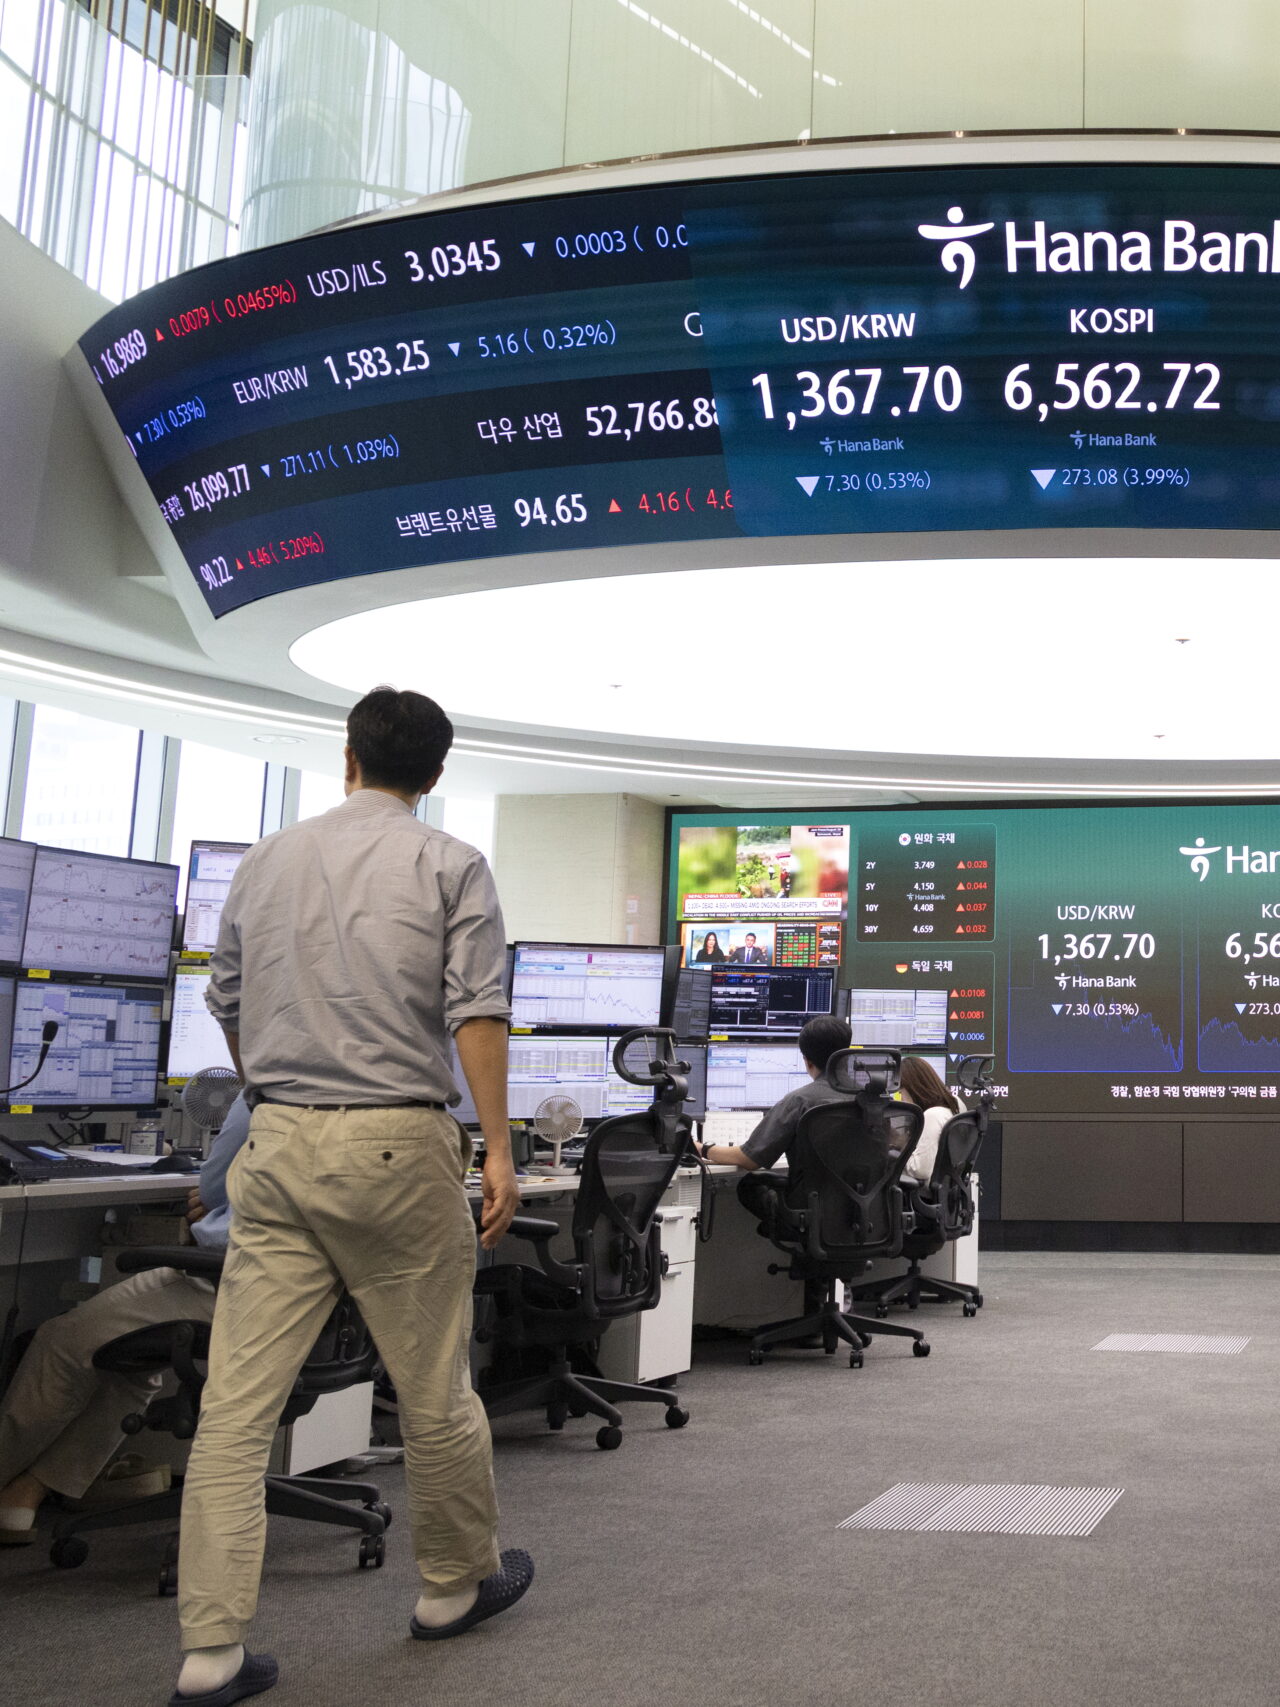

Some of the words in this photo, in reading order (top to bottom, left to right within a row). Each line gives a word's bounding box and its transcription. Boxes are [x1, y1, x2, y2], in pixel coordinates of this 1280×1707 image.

[1005, 220, 1152, 273] Hana
[100, 328, 148, 379] 16.9869
[308, 261, 386, 296] USD/ILS
[404, 238, 500, 282] 3.0345
[781, 313, 916, 343] USD/KRW
[1070, 307, 1154, 334] KOSPI
[233, 366, 308, 403] EUR/KRW
[324, 340, 430, 389] 1,583.25
[752, 365, 962, 431] 1,367.70
[1004, 363, 1221, 422] 6,562.72
[838, 439, 871, 452] Hana
[872, 437, 904, 451] Bank
[1089, 433, 1123, 447] Hana
[1125, 432, 1157, 447] Bank
[184, 464, 250, 512] 26,099.77
[477, 417, 517, 444] 다우
[523, 412, 563, 441] 산업
[825, 474, 860, 492] 7.30
[865, 471, 931, 491] (0.53%)
[1062, 467, 1118, 487] 273.08
[1123, 468, 1190, 488] (3.99%)
[200, 556, 233, 591] 90.22
[397, 504, 498, 537] 브렌트유선물
[515, 494, 587, 527] 94.65
[914, 833, 933, 844] 원화
[937, 833, 955, 844] 국채
[866, 861, 875, 869] 2Y
[914, 861, 934, 869] 3.749
[967, 860, 988, 868] 0.028
[866, 882, 875, 890] 5Y
[914, 882, 934, 891] 4.150
[967, 882, 987, 890] 0.044
[865, 904, 879, 912] 10Y
[913, 903, 934, 912] 4.408
[966, 903, 987, 911] 0.037
[1057, 905, 1135, 922] USD/KRW
[864, 925, 878, 933] 30Y
[913, 925, 933, 933] 4.659
[966, 925, 986, 933] 0.032
[1038, 933, 1155, 966] 1,367.70
[912, 960, 929, 972] 독일
[934, 960, 952, 971] 국채
[1073, 976, 1103, 987] Hana
[1107, 976, 1136, 987] Bank
[960, 989, 985, 997] 0.0108
[960, 1011, 985, 1019] 0.0081
[1065, 1004, 1090, 1016] 7.30
[1093, 1004, 1139, 1016] (0.53%)
[959, 1032, 985, 1041] 0.0006
